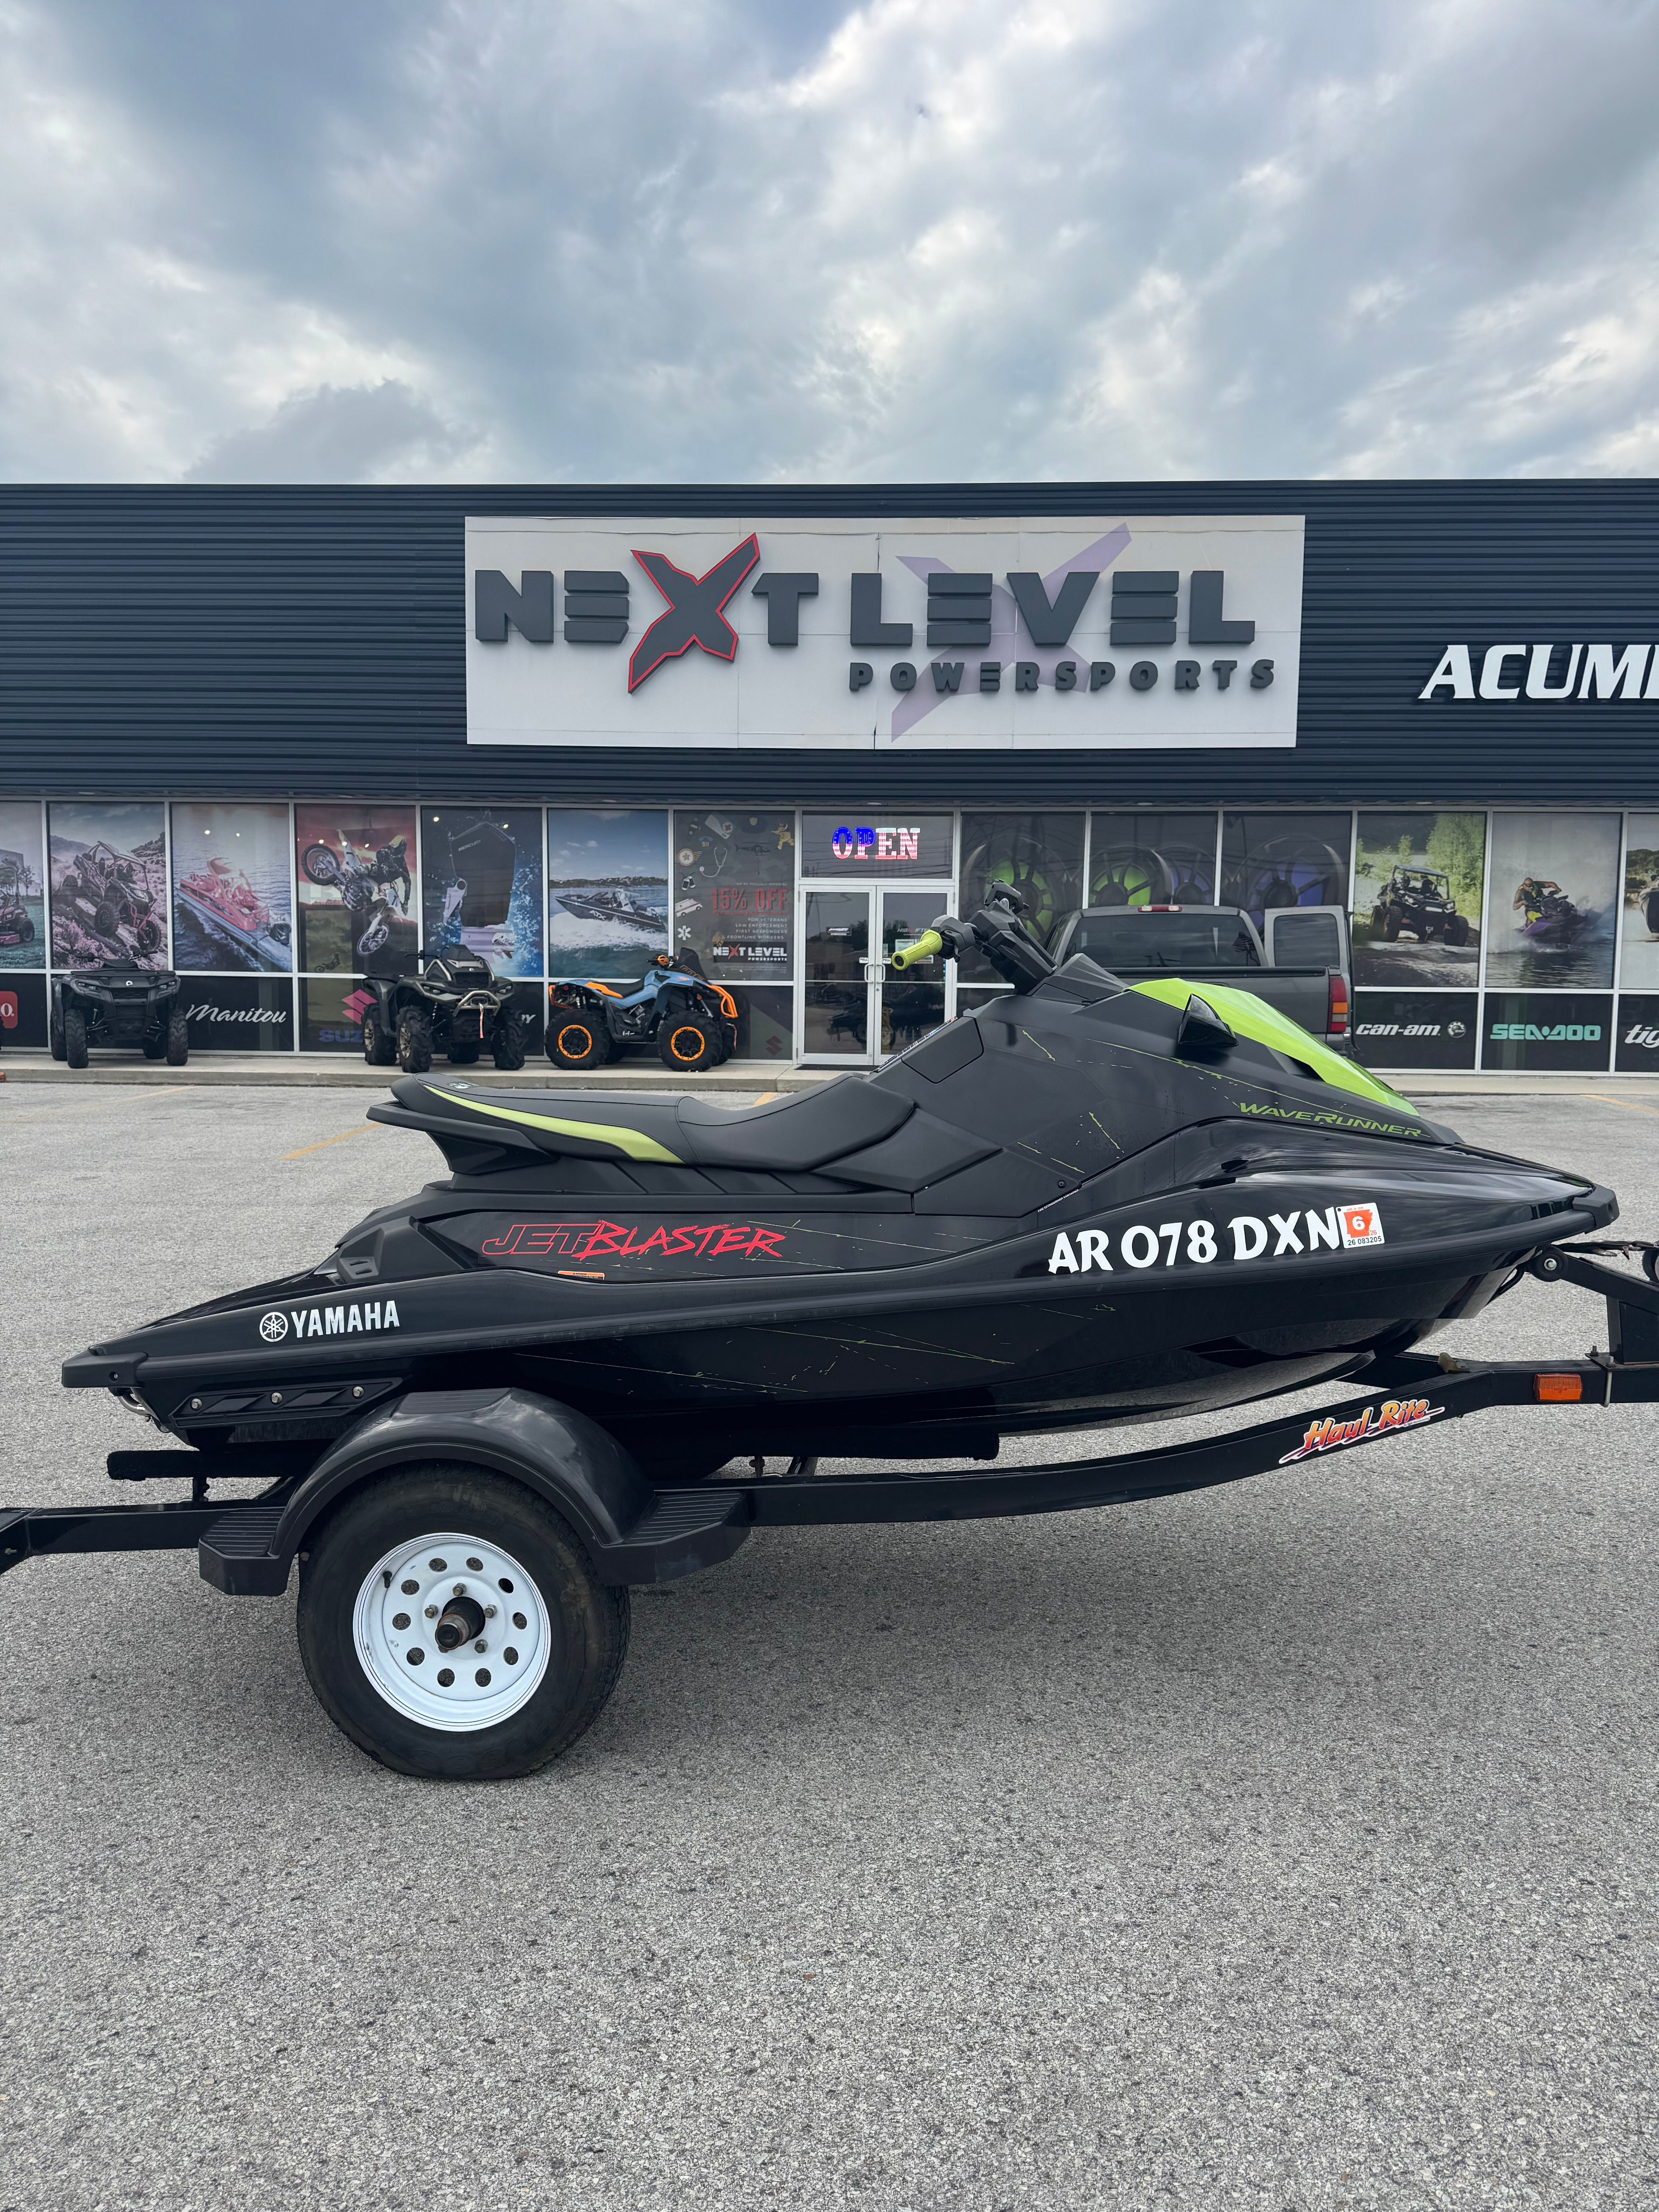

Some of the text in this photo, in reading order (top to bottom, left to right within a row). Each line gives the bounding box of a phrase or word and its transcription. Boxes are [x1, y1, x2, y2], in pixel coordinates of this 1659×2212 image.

[475, 533, 1255, 694] NEXT LEVEL
[849, 659, 1275, 692] POWERSPORTS
[458, 839, 482, 852] MERCURY
[832, 826, 921, 860] OPEN
[711, 888, 788, 910] 15% OFF
[713, 943, 787, 960] NEXT LEVEL
[186, 1004, 287, 1023] Manitou
[1240, 1103, 1421, 1137] WAVERUNNER
[1352, 1216, 1365, 1230] 6
[1048, 1229, 1114, 1274] AR
[1227, 1206, 1340, 1260] DXN
[1357, 1236, 1382, 1244] 083205
[290, 1300, 400, 1338] YAMAHA
[1305, 1399, 1428, 1450] Haul Rite
